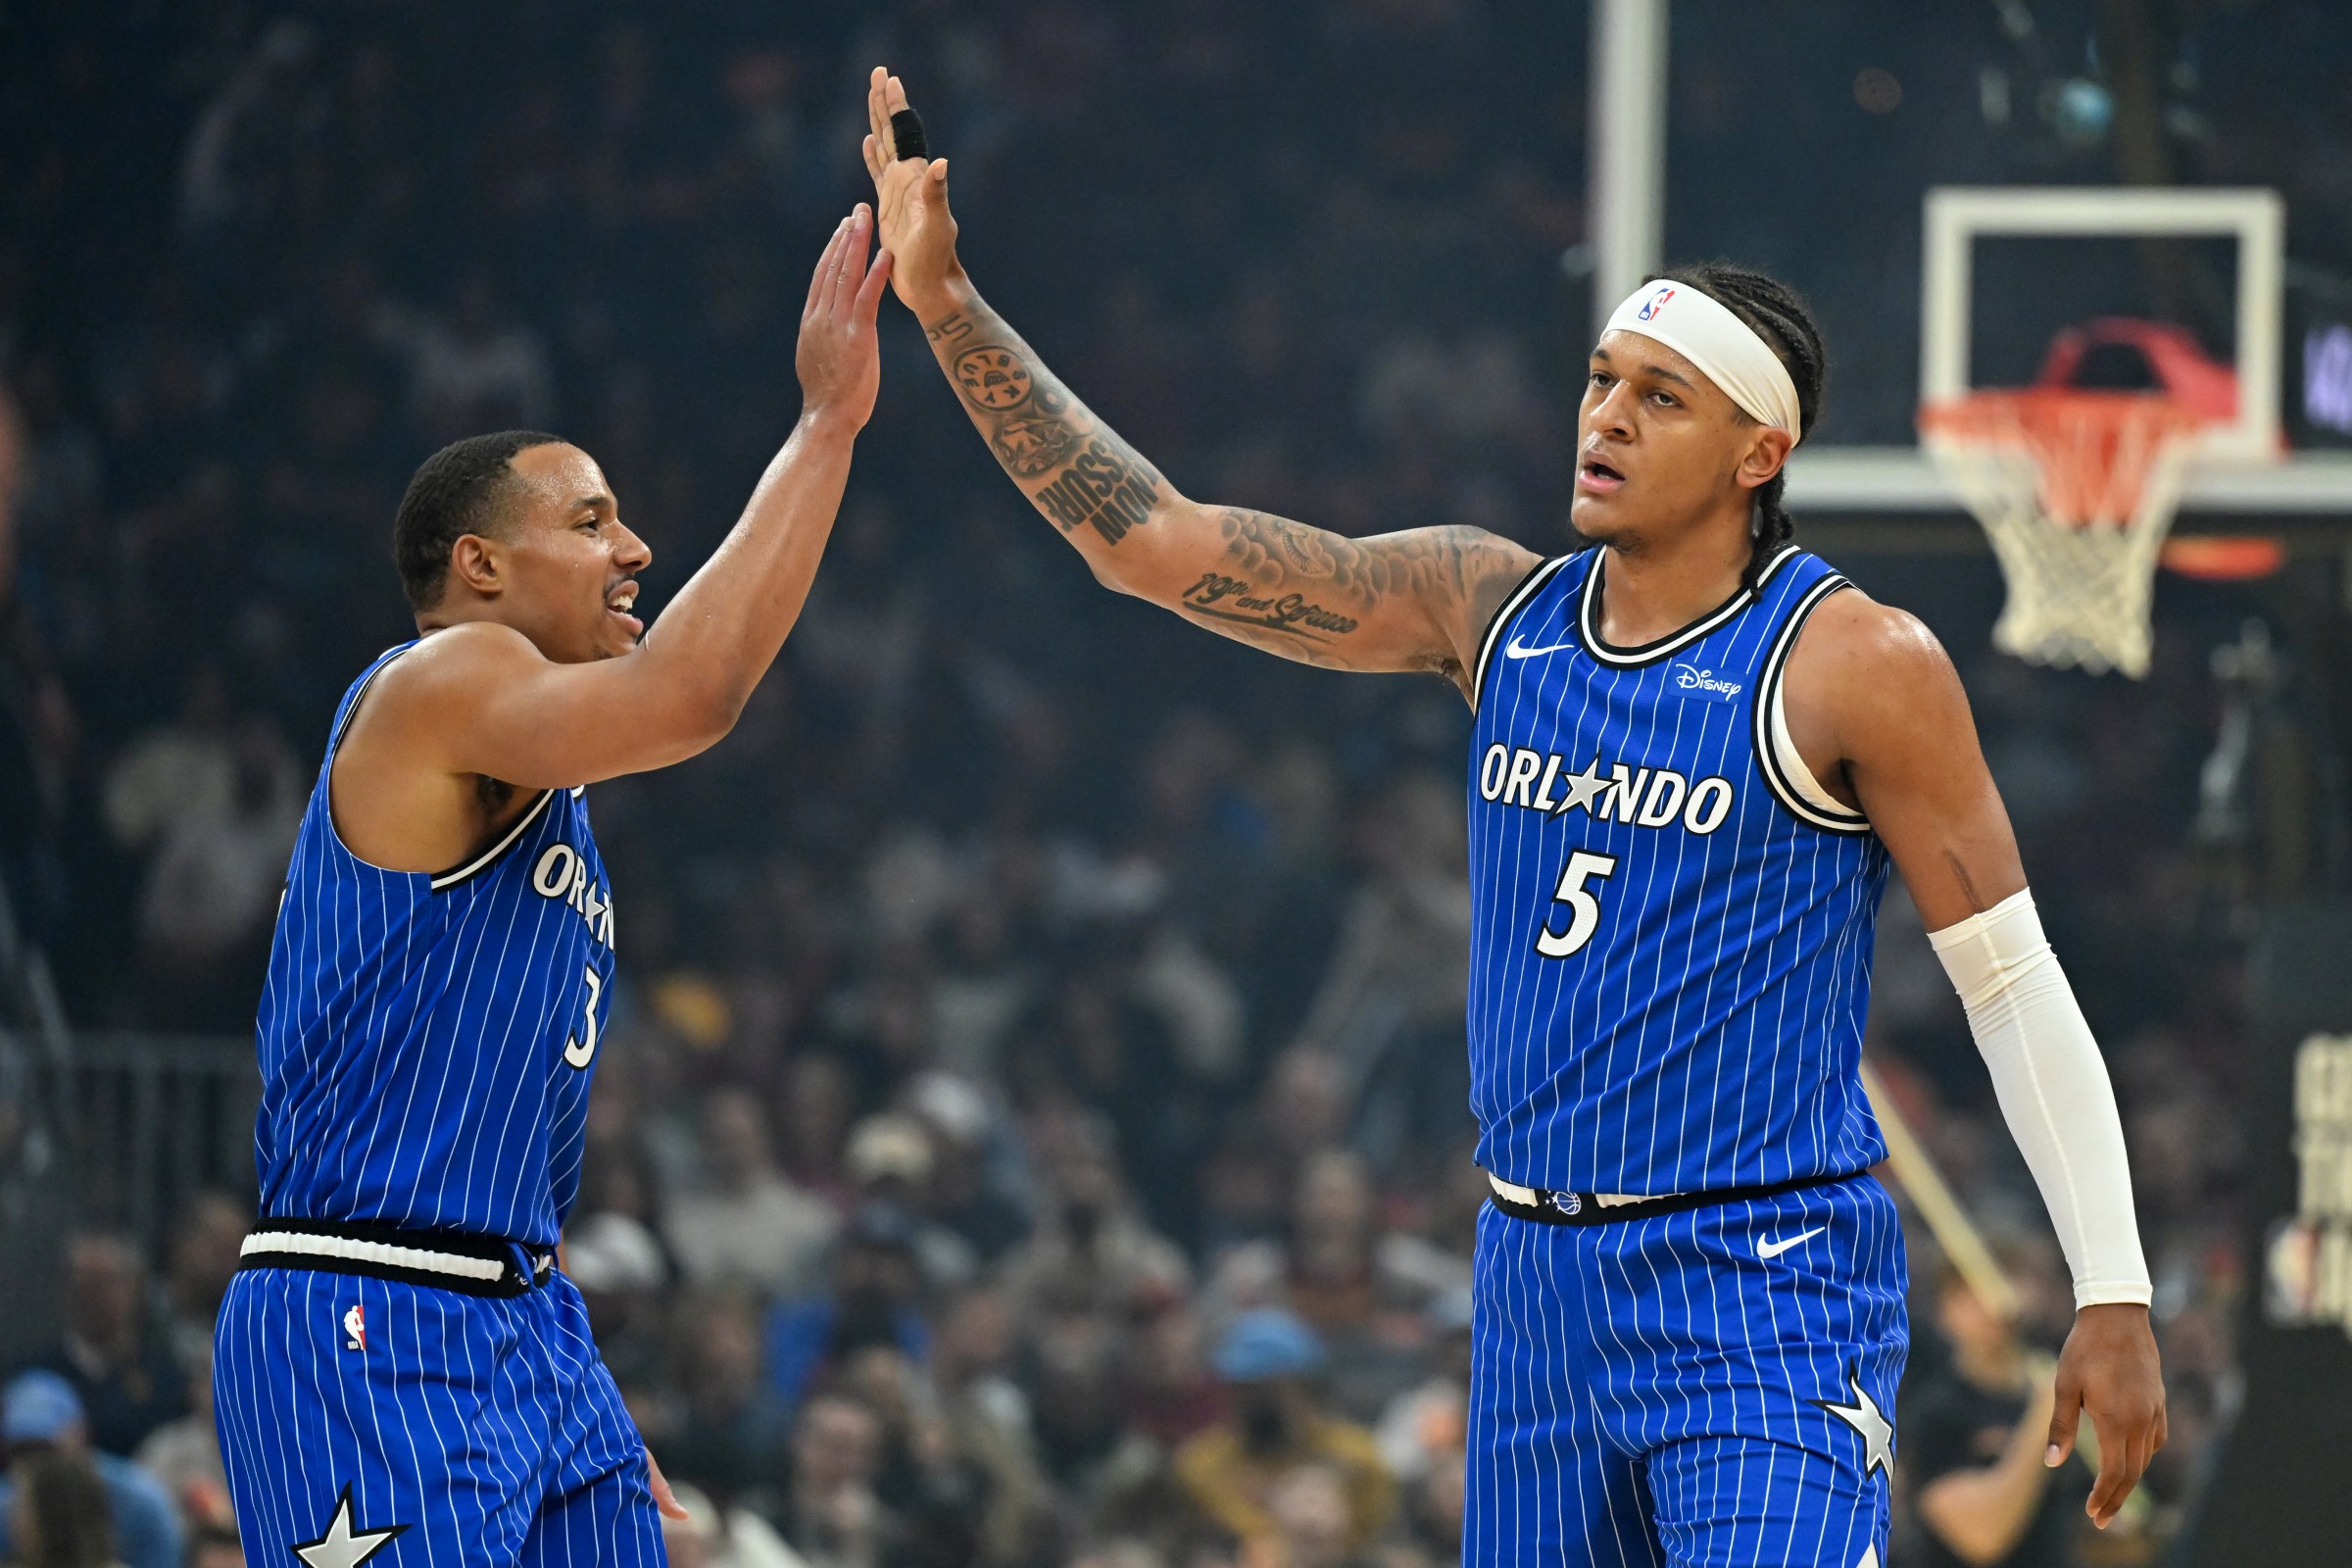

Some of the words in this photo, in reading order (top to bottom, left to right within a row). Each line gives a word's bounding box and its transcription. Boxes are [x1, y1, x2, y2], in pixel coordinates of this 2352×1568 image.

[1236, 596, 1275, 612] and
[1675, 663, 1741, 702] Disney
[1534, 849, 1618, 959] 5
[563, 962, 601, 1071] 3
